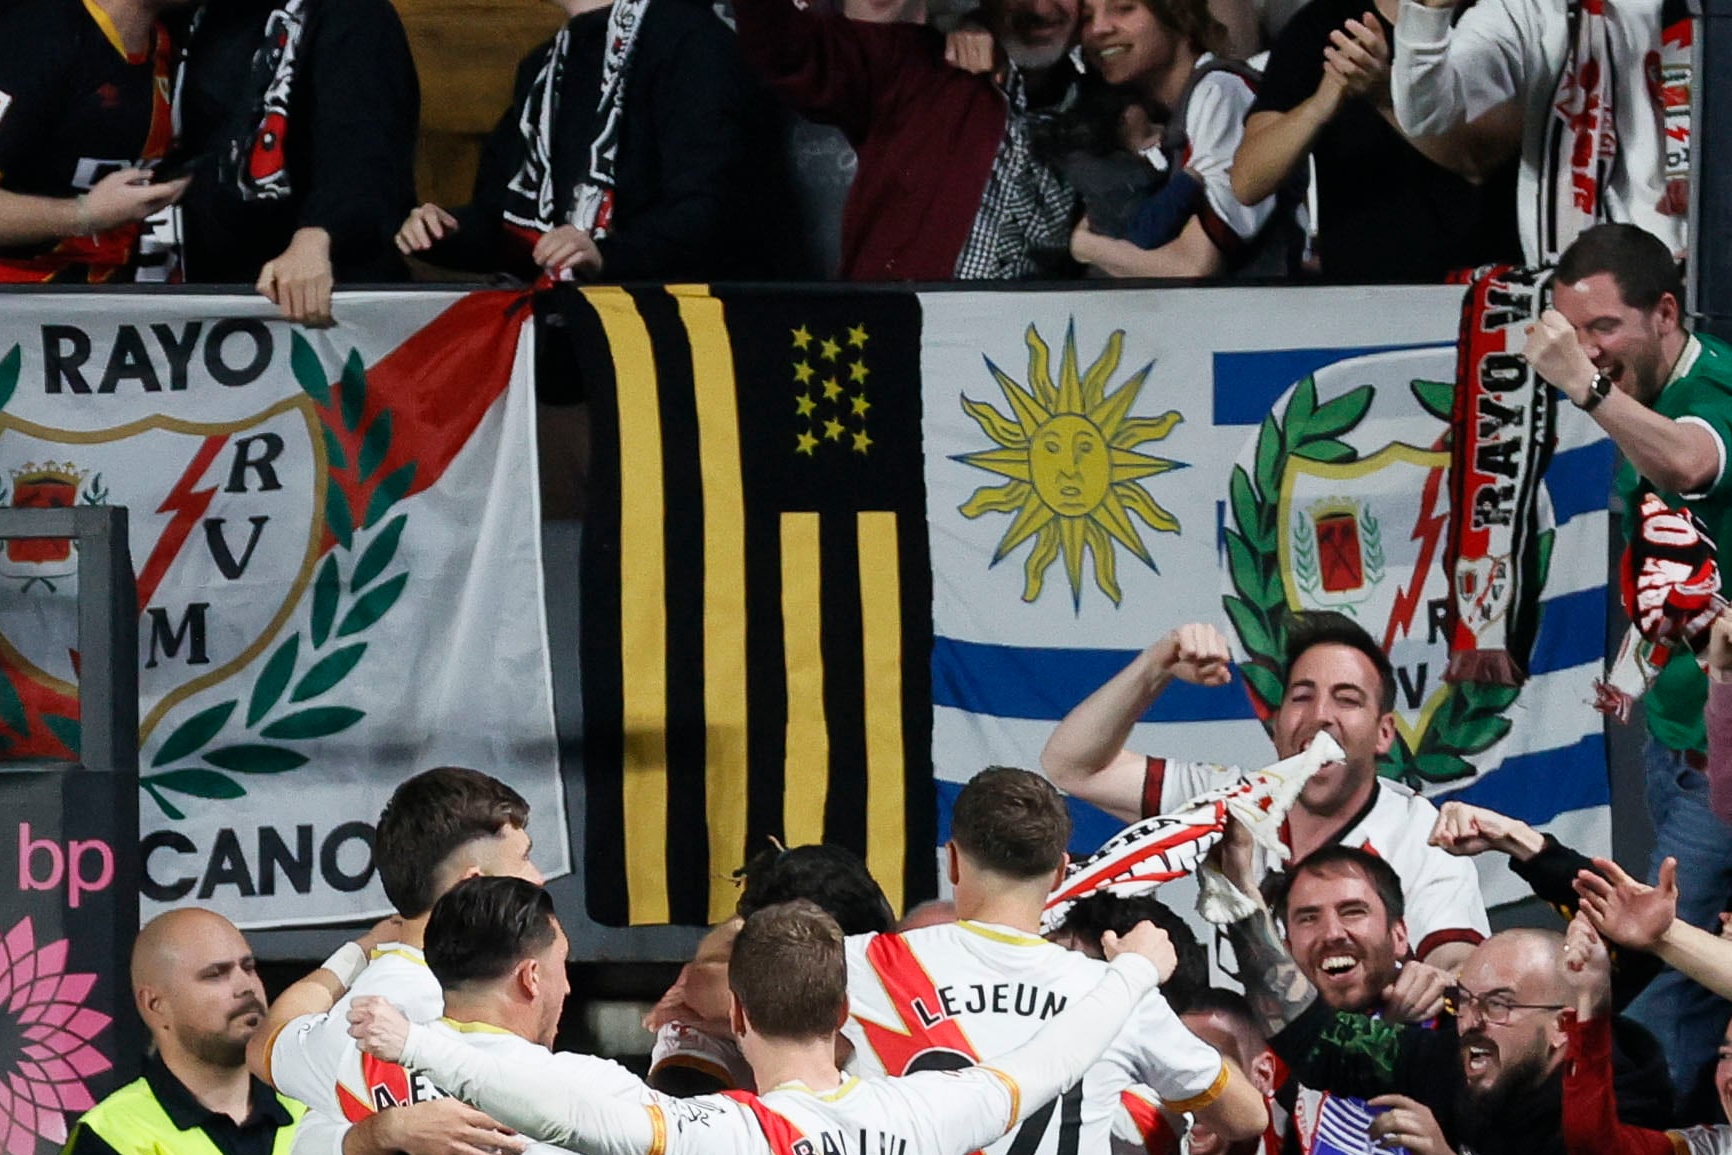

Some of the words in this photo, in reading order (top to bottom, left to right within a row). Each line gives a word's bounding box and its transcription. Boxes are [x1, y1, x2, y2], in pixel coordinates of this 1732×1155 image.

[41, 318, 273, 394] RAYO
[224, 431, 285, 493] R
[1471, 352, 1529, 531] RAYO
[203, 515, 270, 580] V
[145, 602, 210, 669] M
[1398, 662, 1429, 710] V
[18, 821, 115, 909] bp
[911, 982, 1068, 1030] LEJEUN
